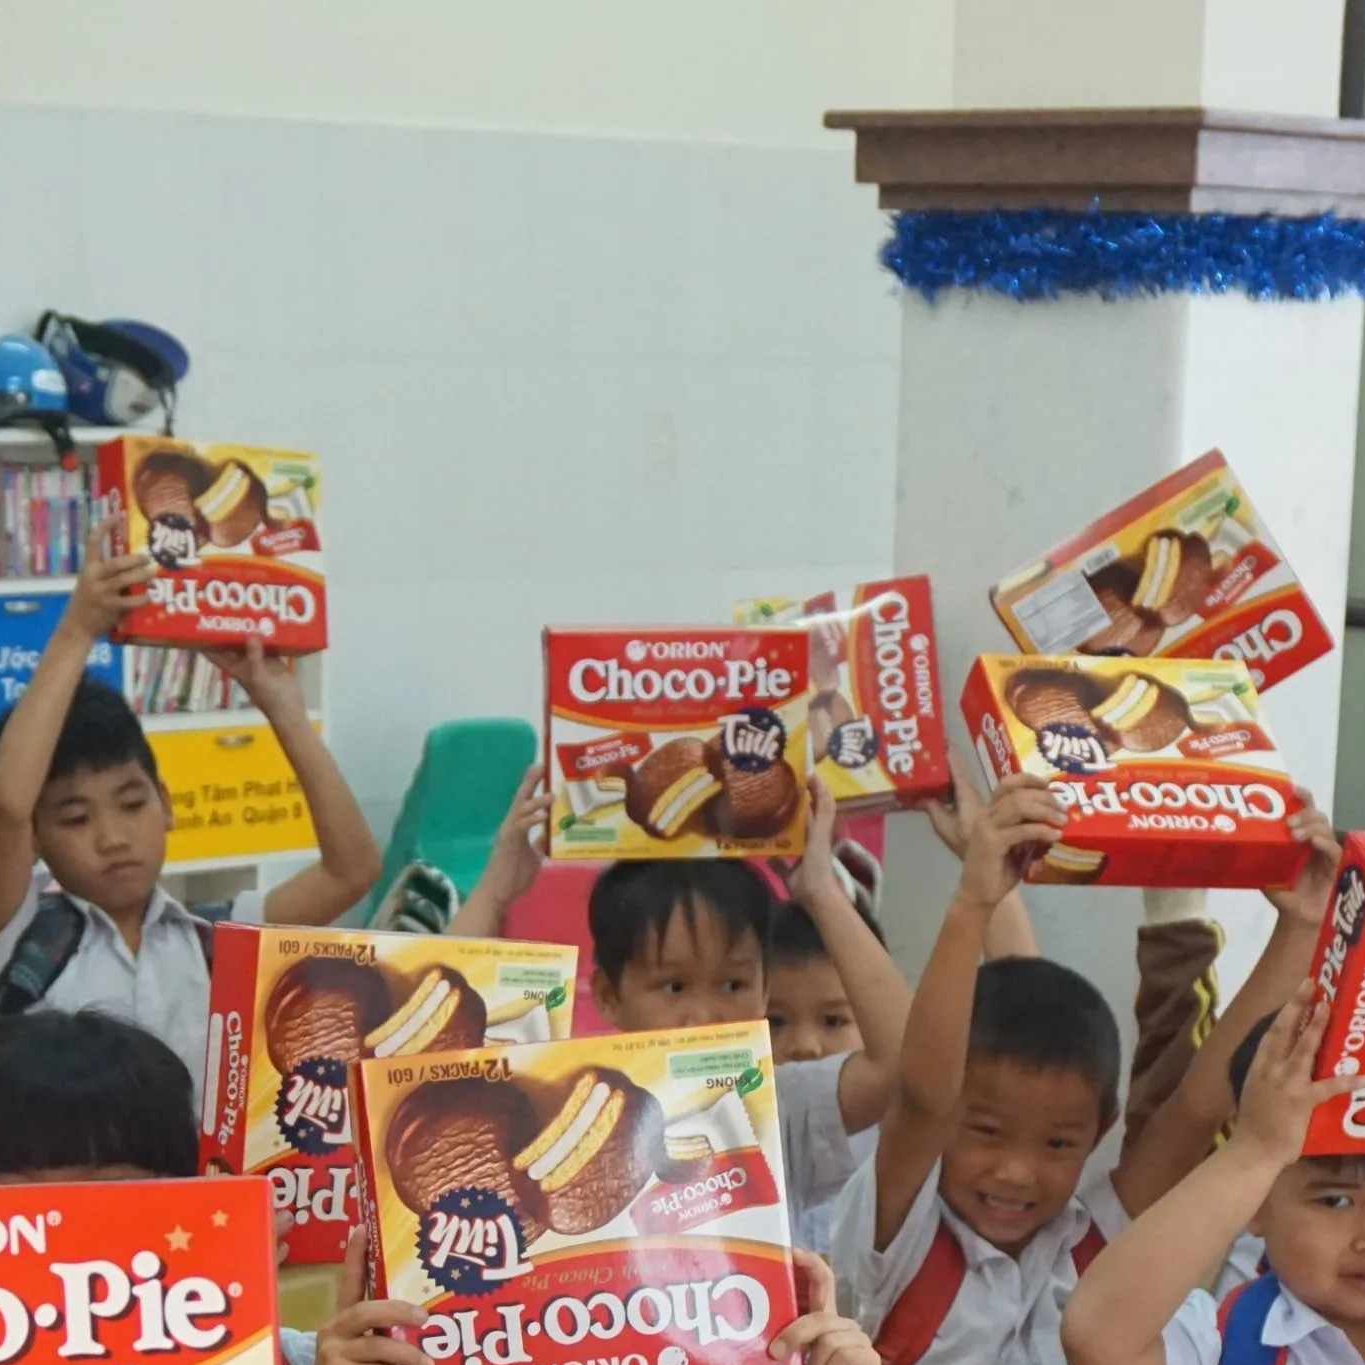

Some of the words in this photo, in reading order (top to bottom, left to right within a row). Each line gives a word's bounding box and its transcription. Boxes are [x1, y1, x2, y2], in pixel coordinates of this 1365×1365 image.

[147, 577, 316, 624] Choco·Pie
[650, 640, 726, 661] ORION
[567, 656, 792, 702] Choco·Pie
[870, 589, 923, 775] Choco·Pie
[1048, 780, 1287, 821] Choco·Pie
[1128, 813, 1215, 831] ORION
[314, 941, 354, 960] PACKS
[355, 943, 379, 965] 12
[223, 1010, 243, 1147] Choco·Pie
[387, 1066, 414, 1087] GÓI
[429, 1062, 482, 1081] PACKS
[484, 1057, 513, 1083] 12
[652, 1167, 748, 1216] Choco·Pie
[432, 1209, 533, 1281] Tình
